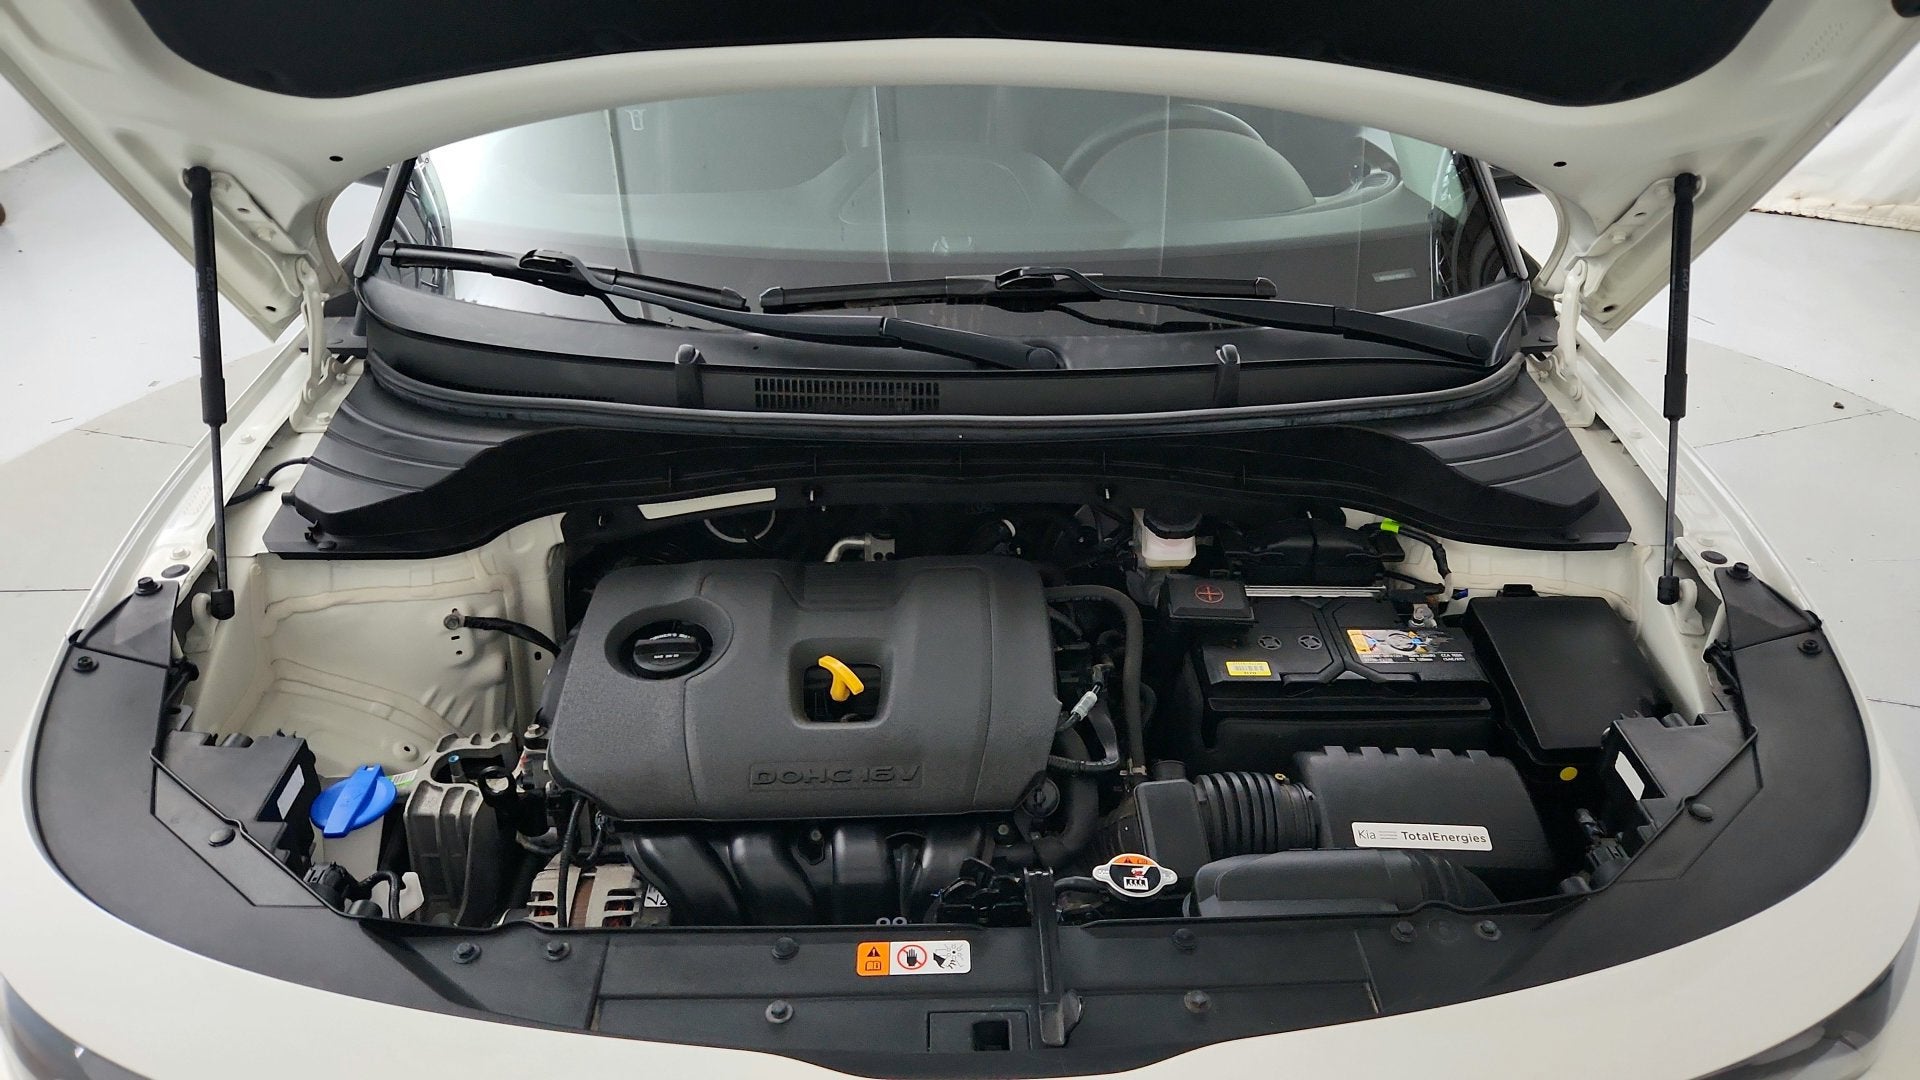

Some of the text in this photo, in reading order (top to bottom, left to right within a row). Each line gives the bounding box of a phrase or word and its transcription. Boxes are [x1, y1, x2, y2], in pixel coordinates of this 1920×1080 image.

[751, 765, 920, 785] DOHC 16V
[1358, 829, 1487, 843] Kia TotalEnergies
